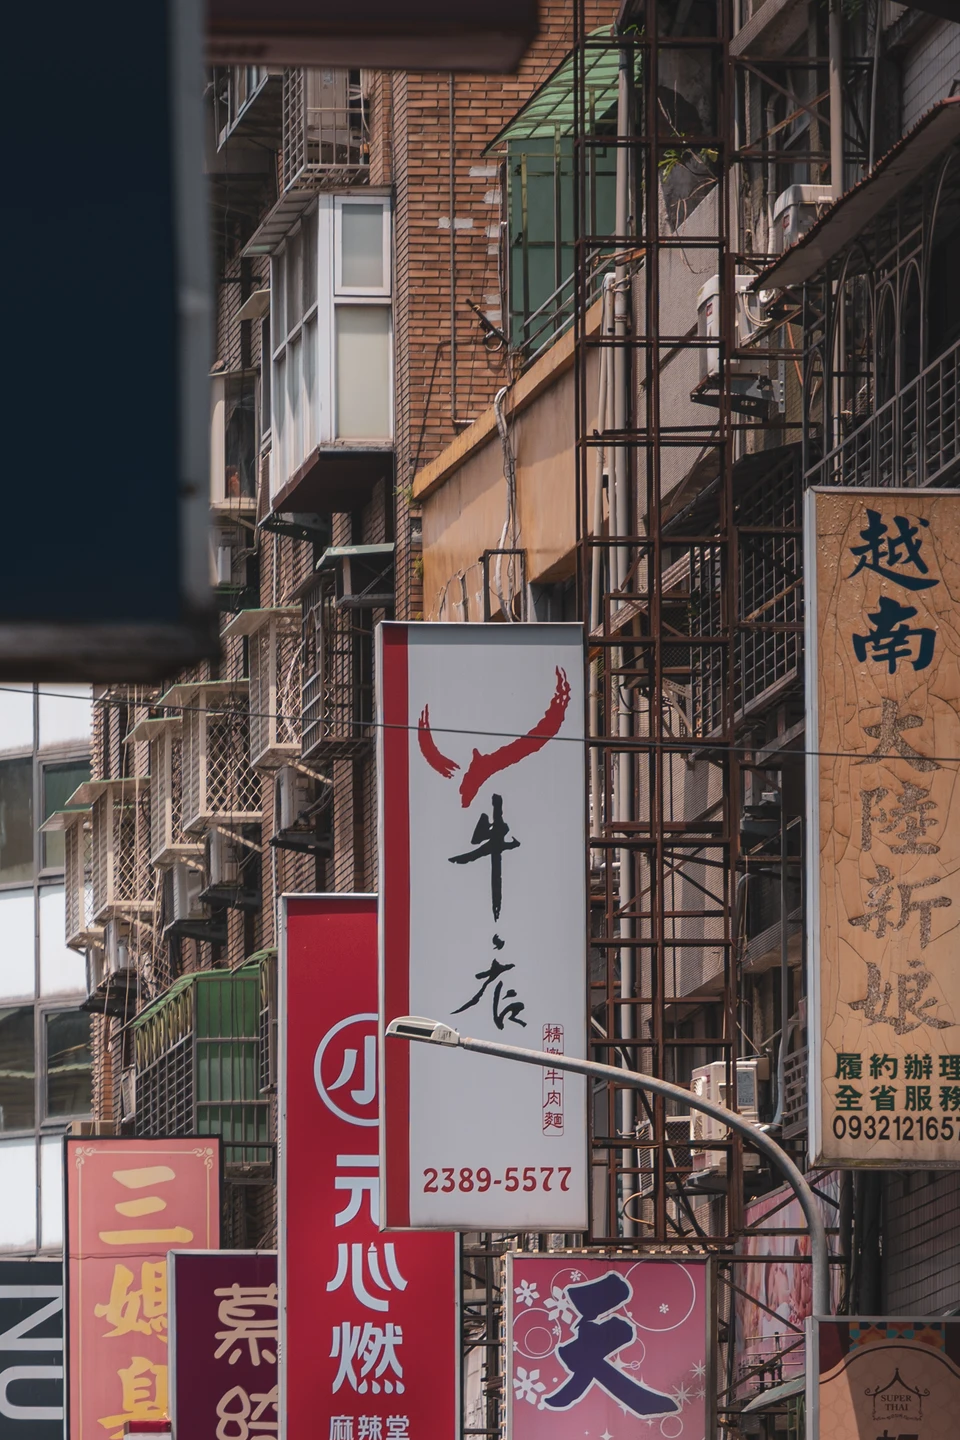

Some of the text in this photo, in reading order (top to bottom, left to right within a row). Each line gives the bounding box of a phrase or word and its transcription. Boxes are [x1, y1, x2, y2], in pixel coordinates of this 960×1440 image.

[835, 1084, 960, 1112] 全省服務
[422, 1167, 572, 1194] 2389-5577
[880, 1394, 912, 1403] SUPER
[884, 1403, 909, 1411] THAI
